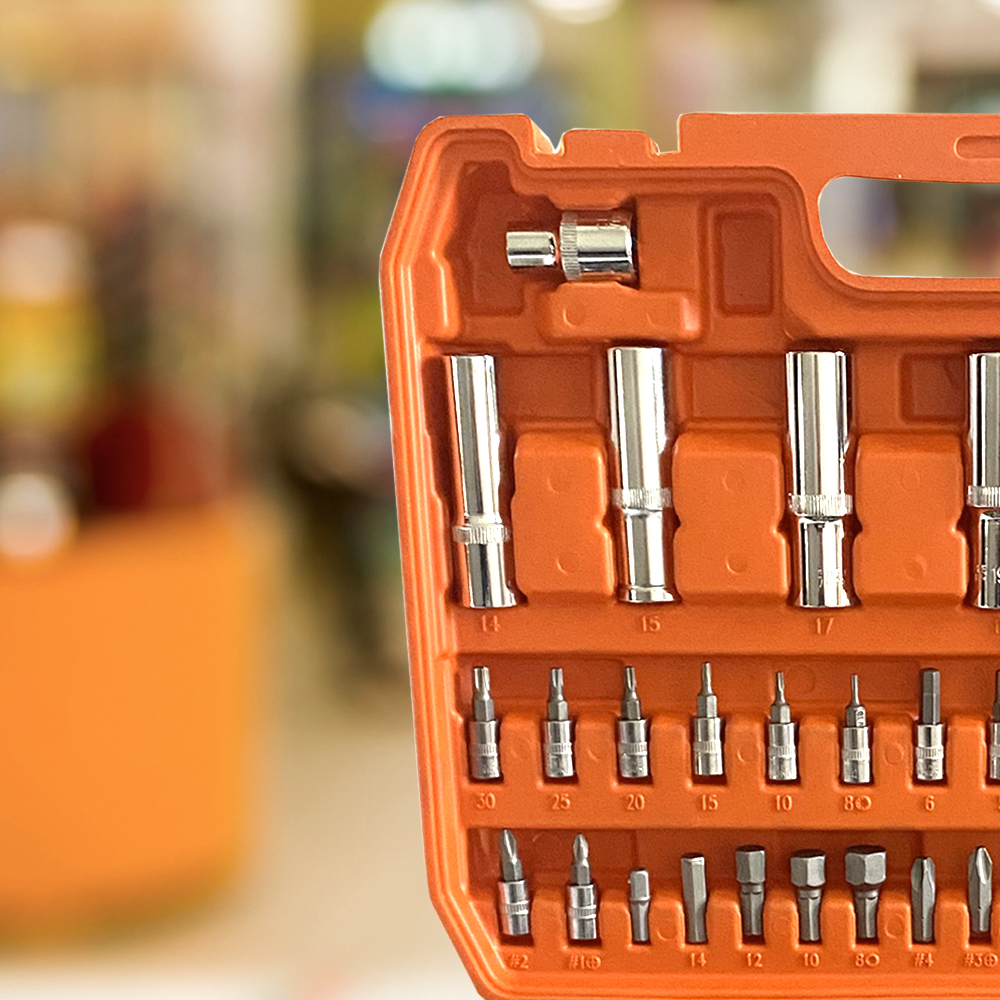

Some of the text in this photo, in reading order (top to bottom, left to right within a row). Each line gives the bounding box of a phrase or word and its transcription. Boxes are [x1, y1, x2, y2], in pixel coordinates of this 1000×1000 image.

[481, 616, 501, 632] 14
[641, 616, 661, 632] 15
[815, 617, 835, 635] 17
[476, 795, 496, 811] 30
[551, 794, 571, 811] 25
[625, 794, 646, 811] 20
[701, 794, 718, 811] 15
[775, 794, 793, 811] 10
[924, 795, 935, 811] 6
[690, 953, 707, 968] 14
[747, 953, 764, 968] 12
[803, 953, 820, 968] 10
[914, 953, 934, 968] #4
